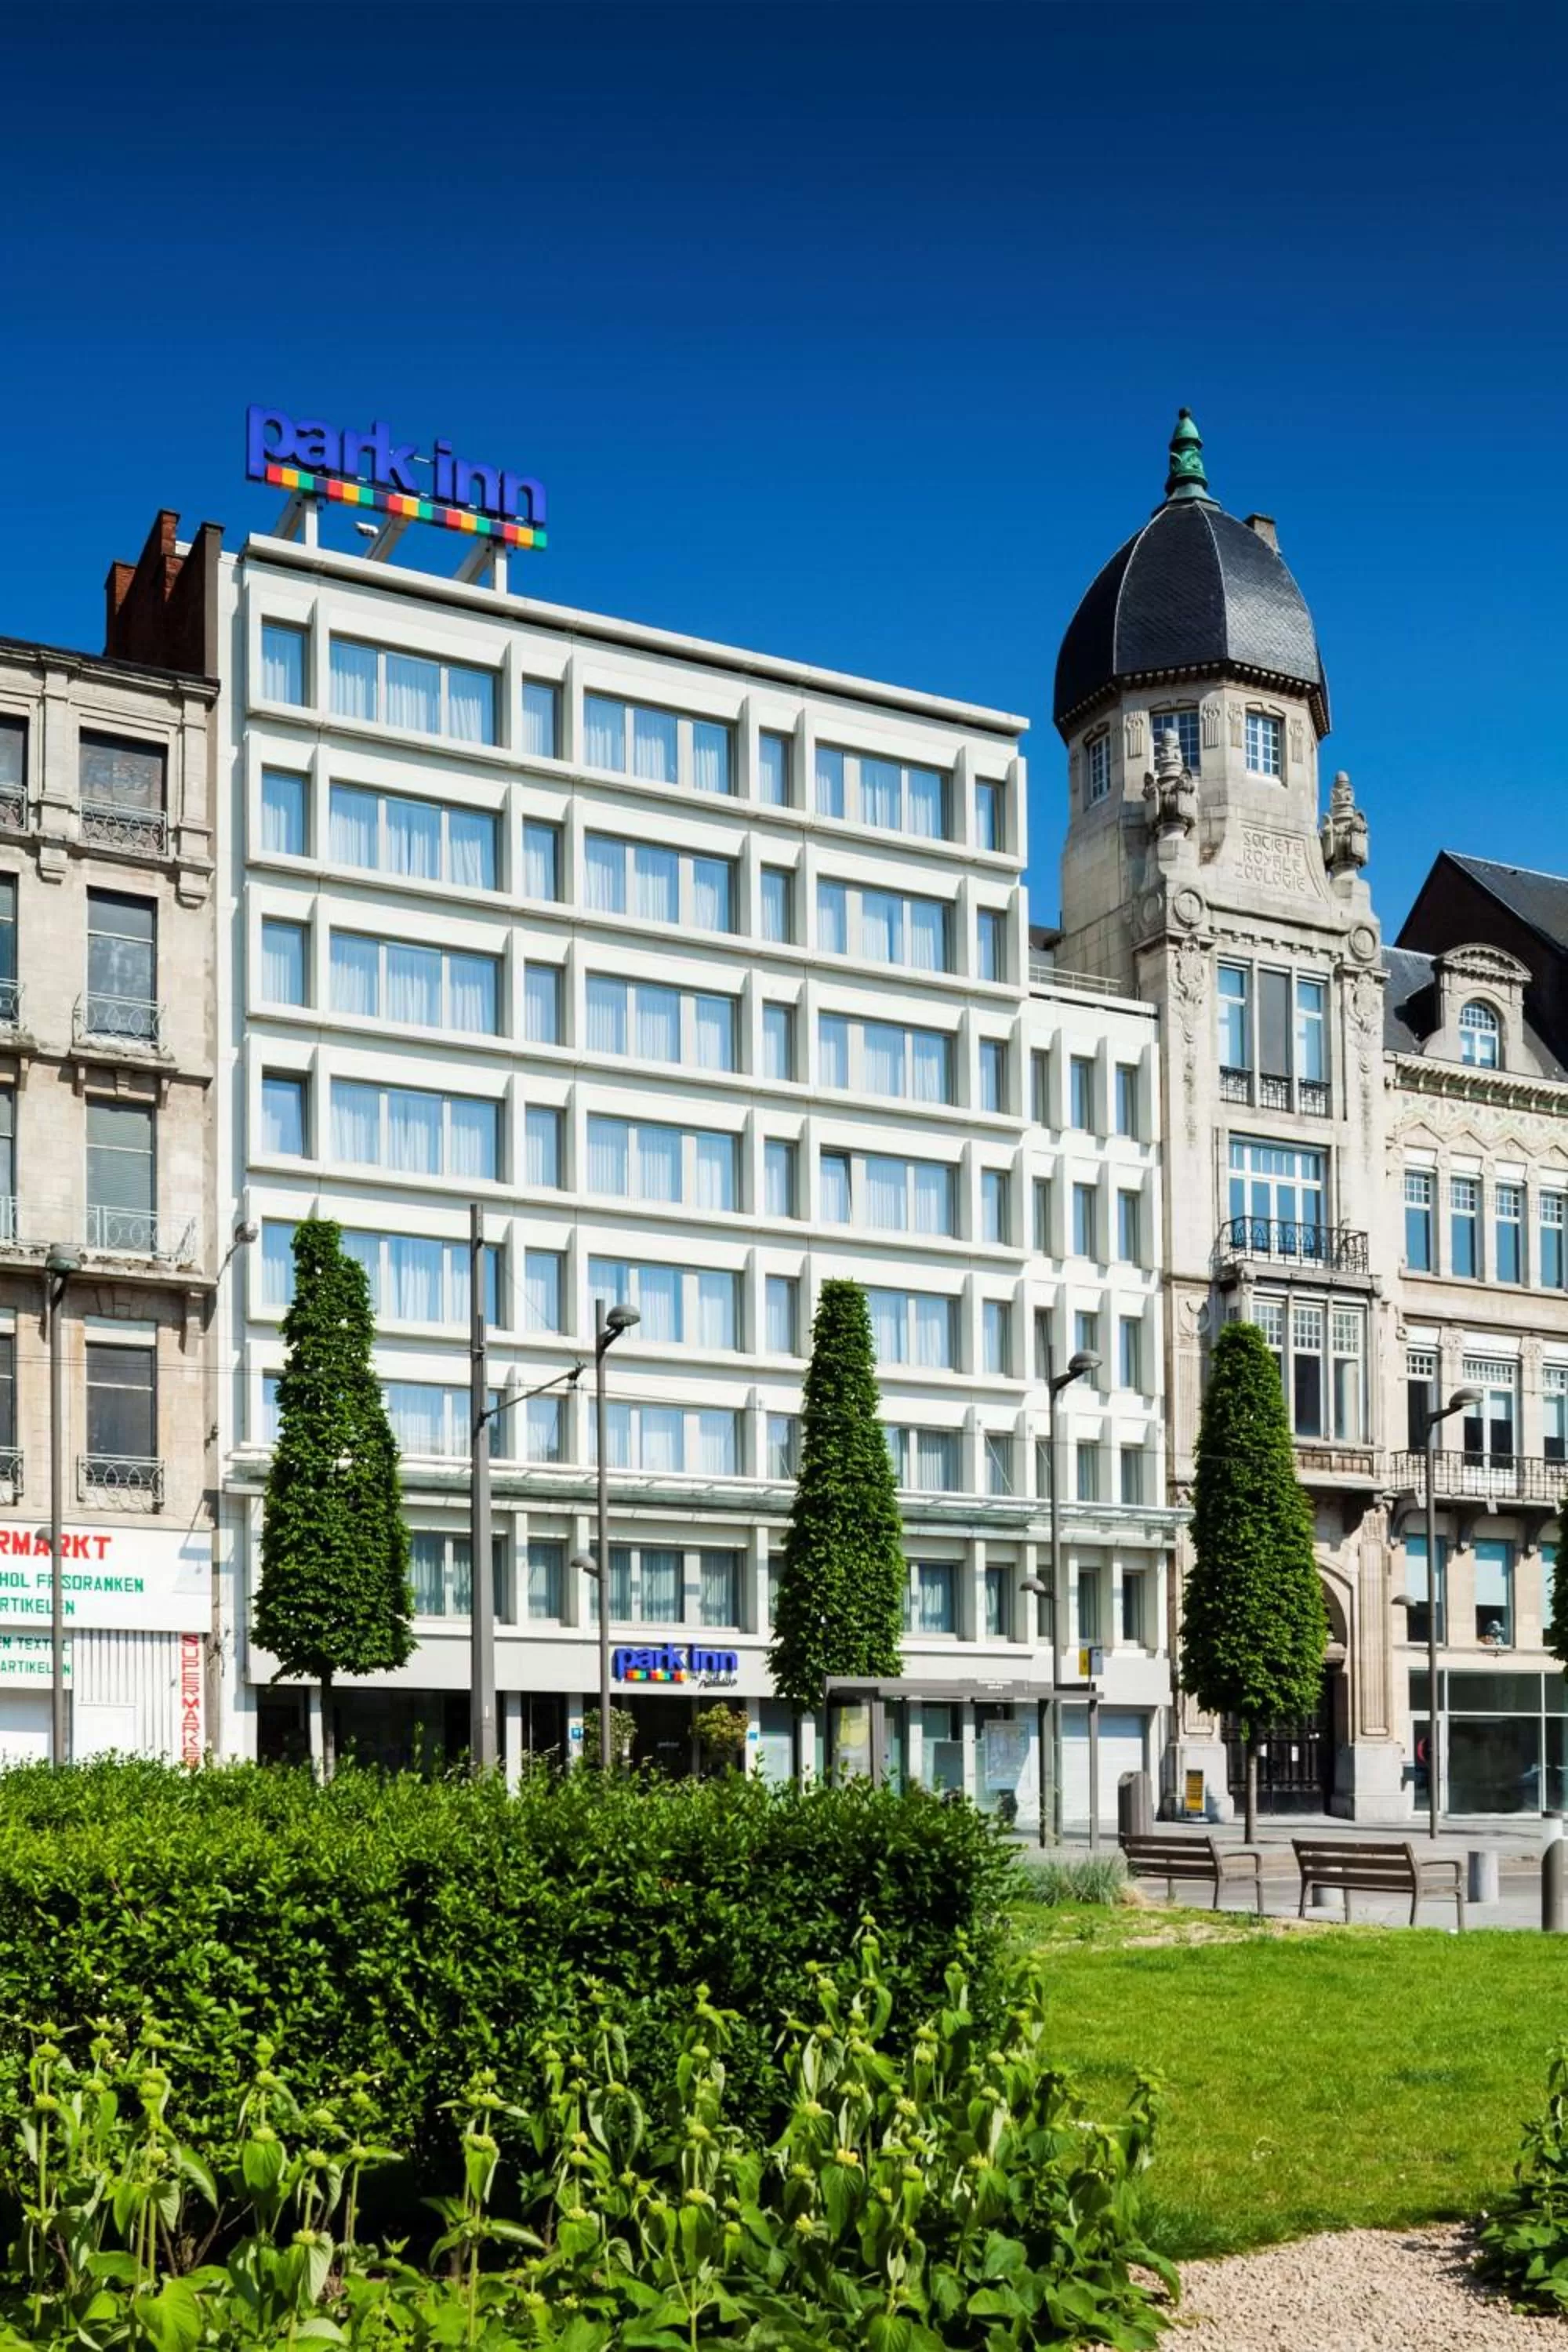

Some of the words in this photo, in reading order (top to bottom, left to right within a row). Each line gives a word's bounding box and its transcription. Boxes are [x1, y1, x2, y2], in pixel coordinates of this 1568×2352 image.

[246, 404, 420, 494] park
[434, 437, 547, 527] inn
[1243, 848, 1303, 875] ROYALE
[1234, 862, 1305, 892] ZOOLOGIE
[36, 1573, 144, 1593] FRSDRANKEN
[0, 1596, 75, 1616] RTIKELN
[1, 1659, 71, 1675] ARTIKELN
[612, 1643, 687, 1682] park
[687, 1643, 739, 1671] inn
[181, 1634, 201, 1762] SUPERMARKE
